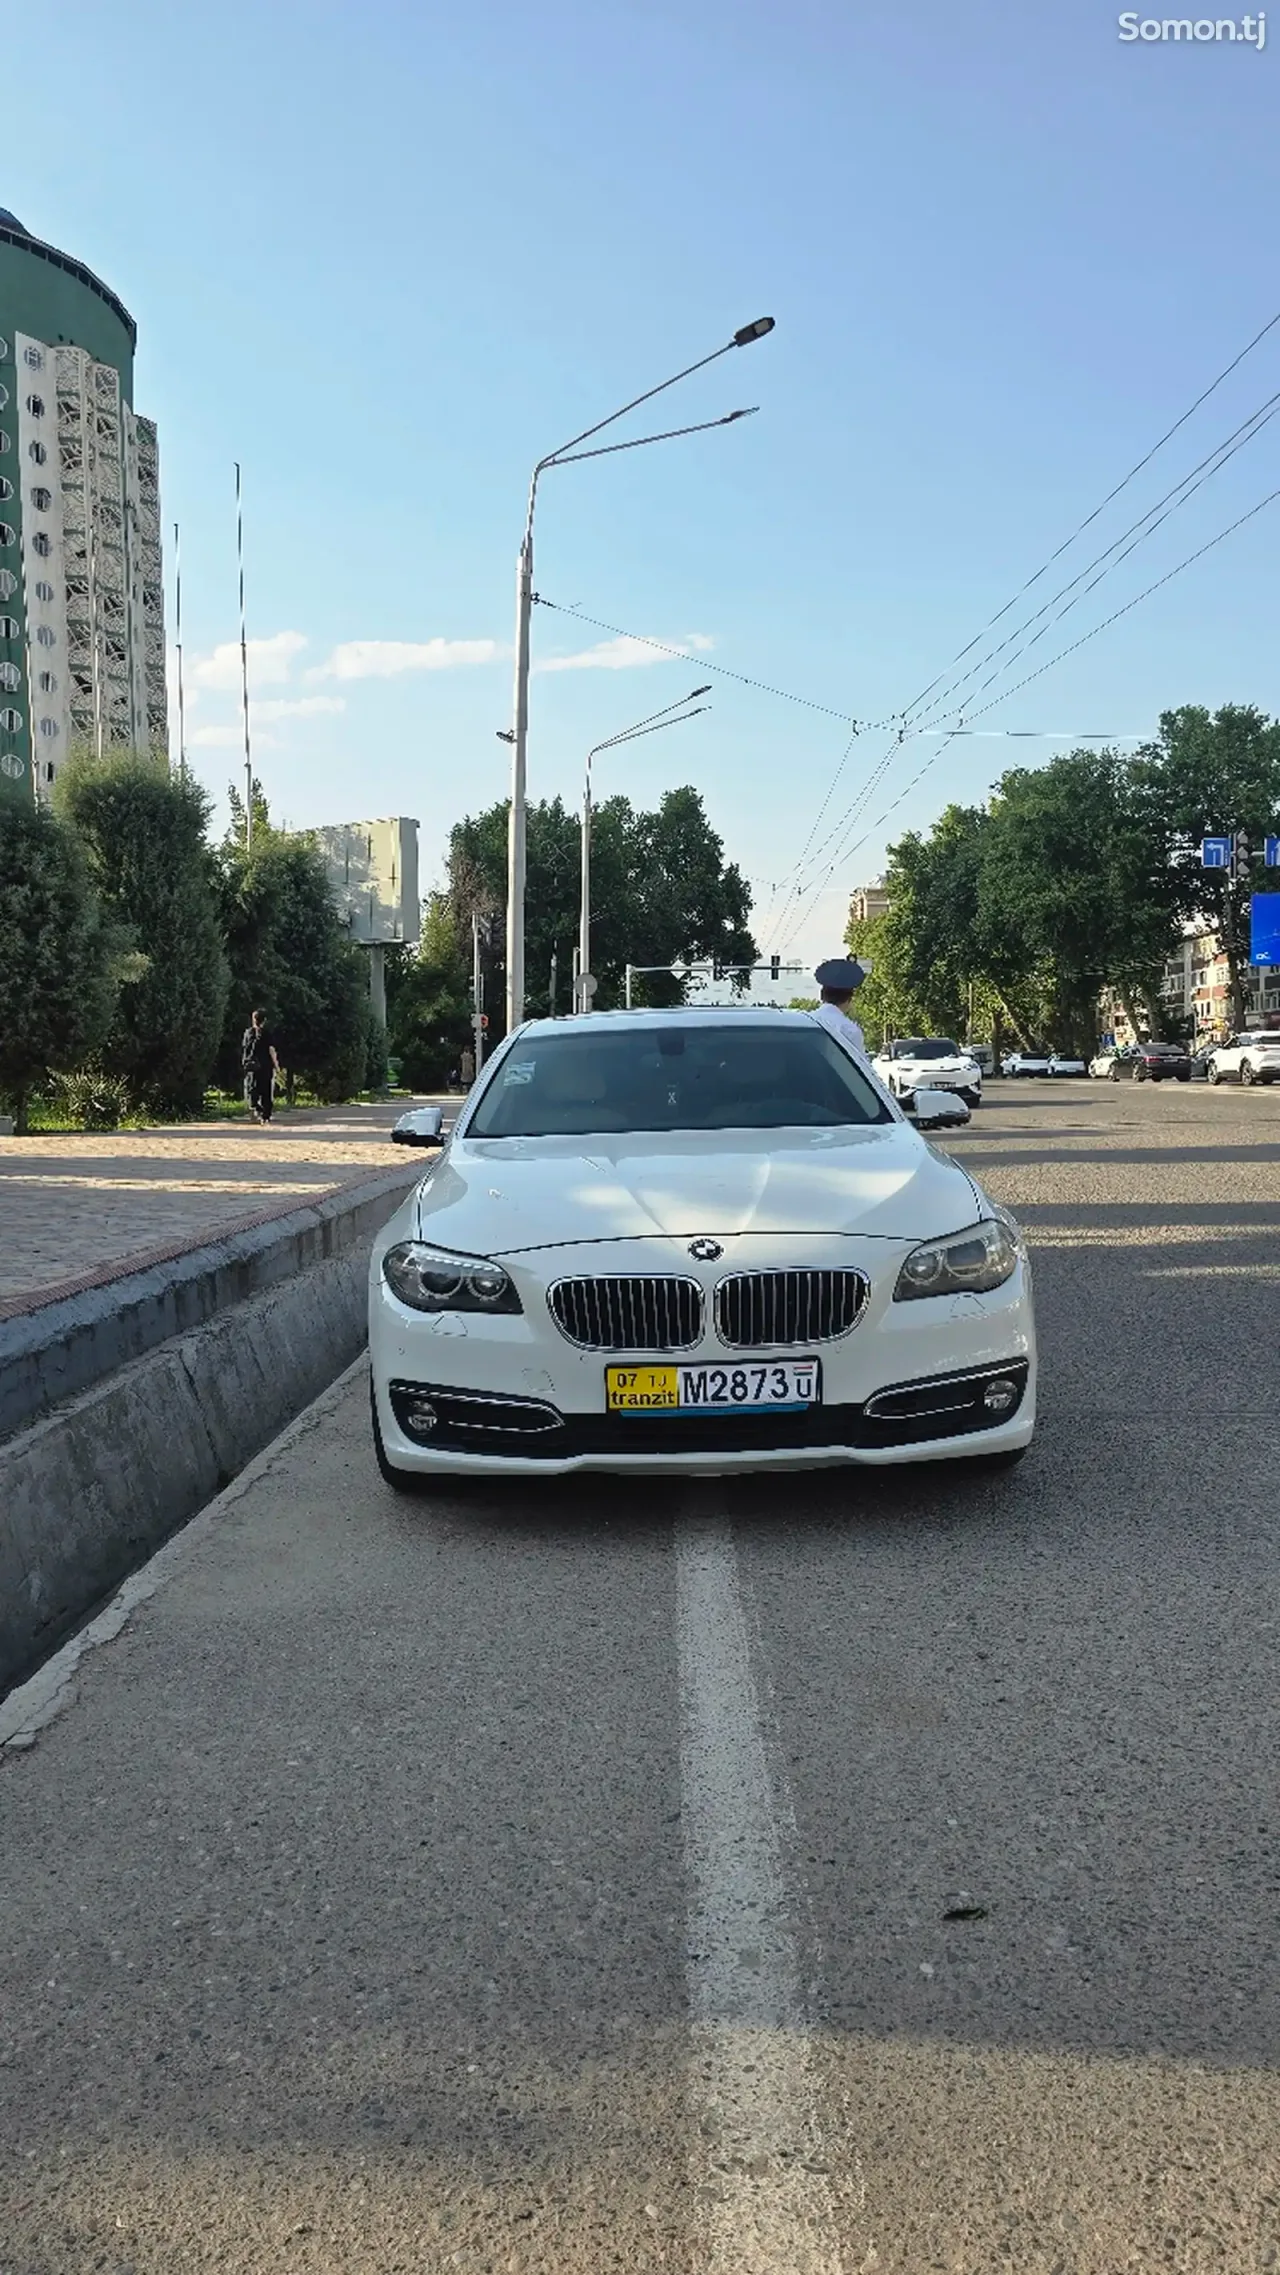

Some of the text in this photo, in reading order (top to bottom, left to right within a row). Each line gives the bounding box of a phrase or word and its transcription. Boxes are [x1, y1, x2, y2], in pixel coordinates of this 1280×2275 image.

[617, 1373, 637, 1388] 07
[682, 1368, 789, 1403] M2873
[610, 1390, 675, 1406] tranzit
